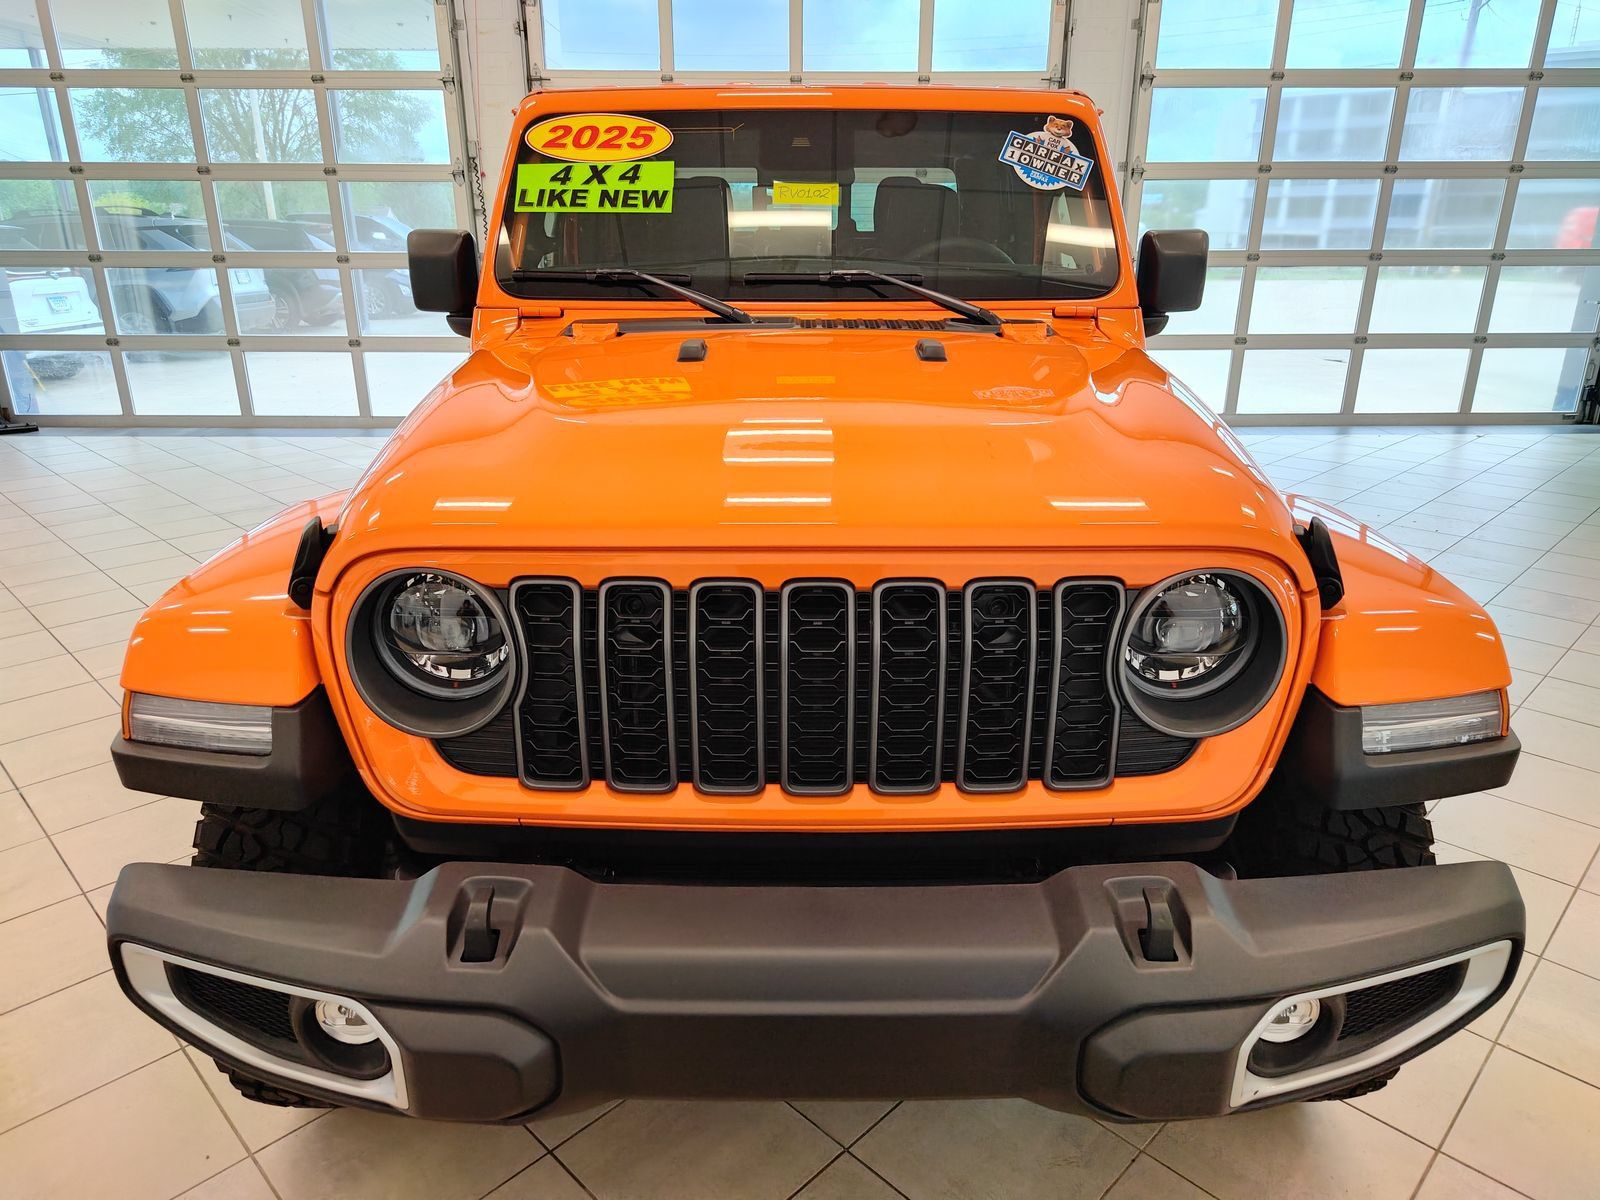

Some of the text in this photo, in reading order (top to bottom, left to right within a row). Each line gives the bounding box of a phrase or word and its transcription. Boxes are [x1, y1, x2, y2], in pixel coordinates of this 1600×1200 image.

[541, 125, 657, 149] 2025
[1047, 141, 1059, 150] FOX
[1048, 137, 1061, 146] CAR
[1007, 150, 1016, 160] 1
[1019, 154, 1081, 183] OWNER
[1012, 138, 1086, 173] CARFAX
[549, 163, 643, 186] 4 X 4
[517, 188, 669, 209] LIKE NEW
